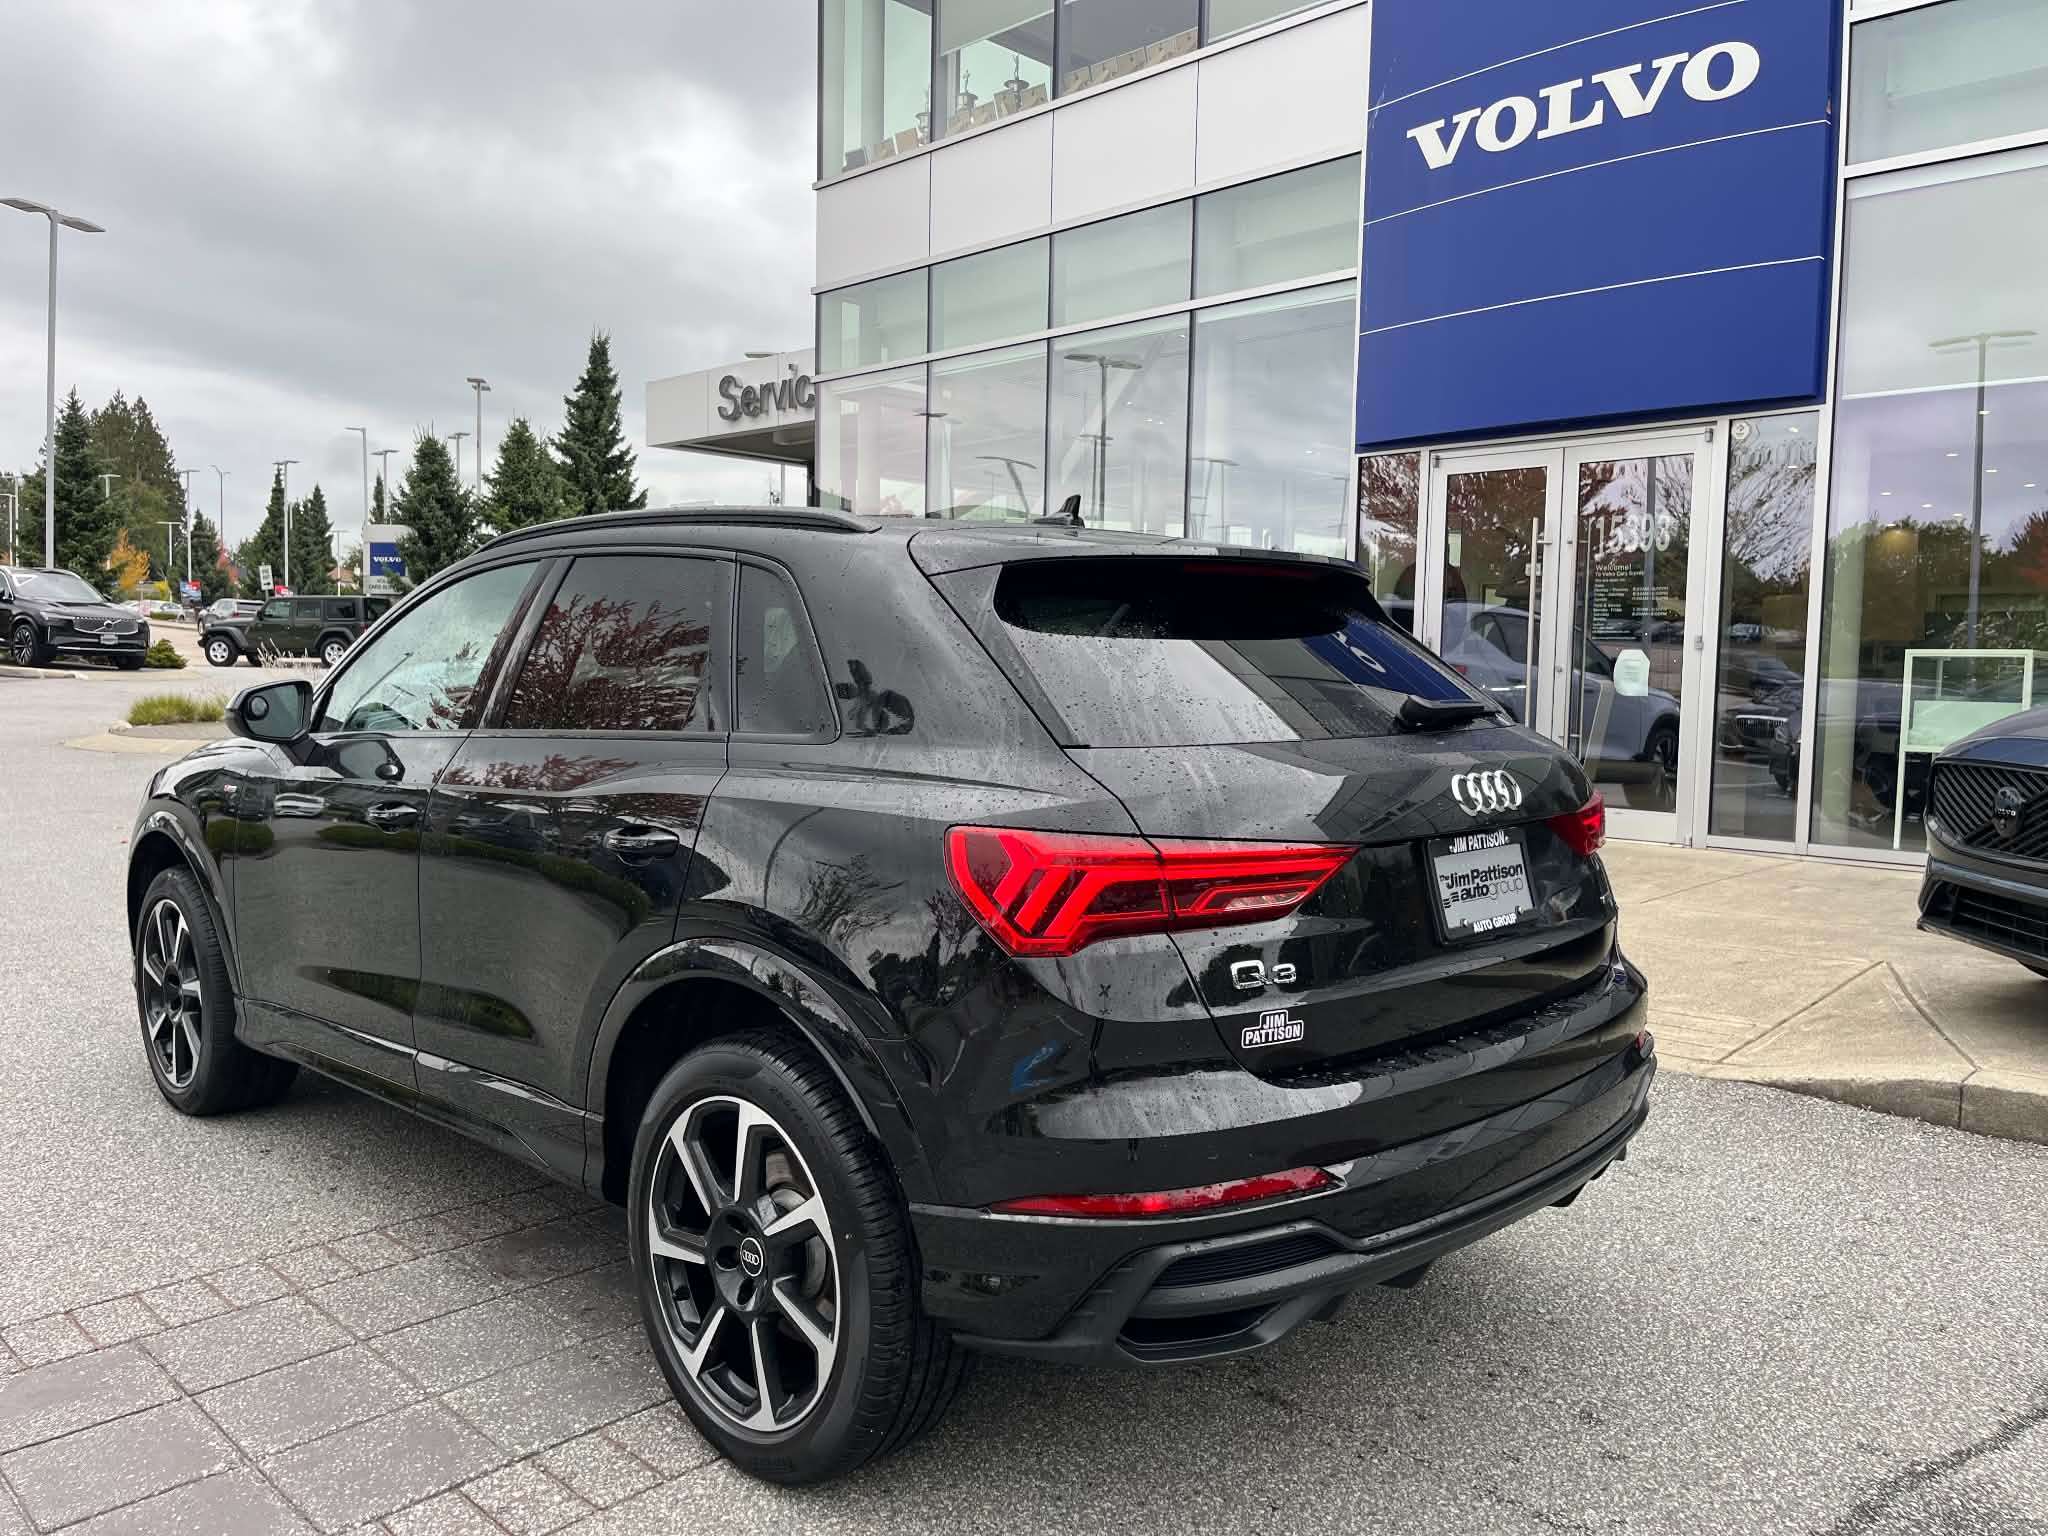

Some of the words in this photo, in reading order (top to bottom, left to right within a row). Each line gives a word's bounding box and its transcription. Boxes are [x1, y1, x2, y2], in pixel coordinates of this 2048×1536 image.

[1406, 41, 1760, 170] VOLVO
[1595, 563, 1632, 571] Welcome!
[1453, 837, 1467, 853] JIM
[1467, 831, 1505, 850] PATTISON
[1473, 916, 1493, 933] AUTO
[1493, 912, 1517, 930] GROUP
[1230, 960, 1297, 990] Q3
[1263, 1014, 1285, 1029] JIM
[1245, 1024, 1301, 1045] PATTISON
